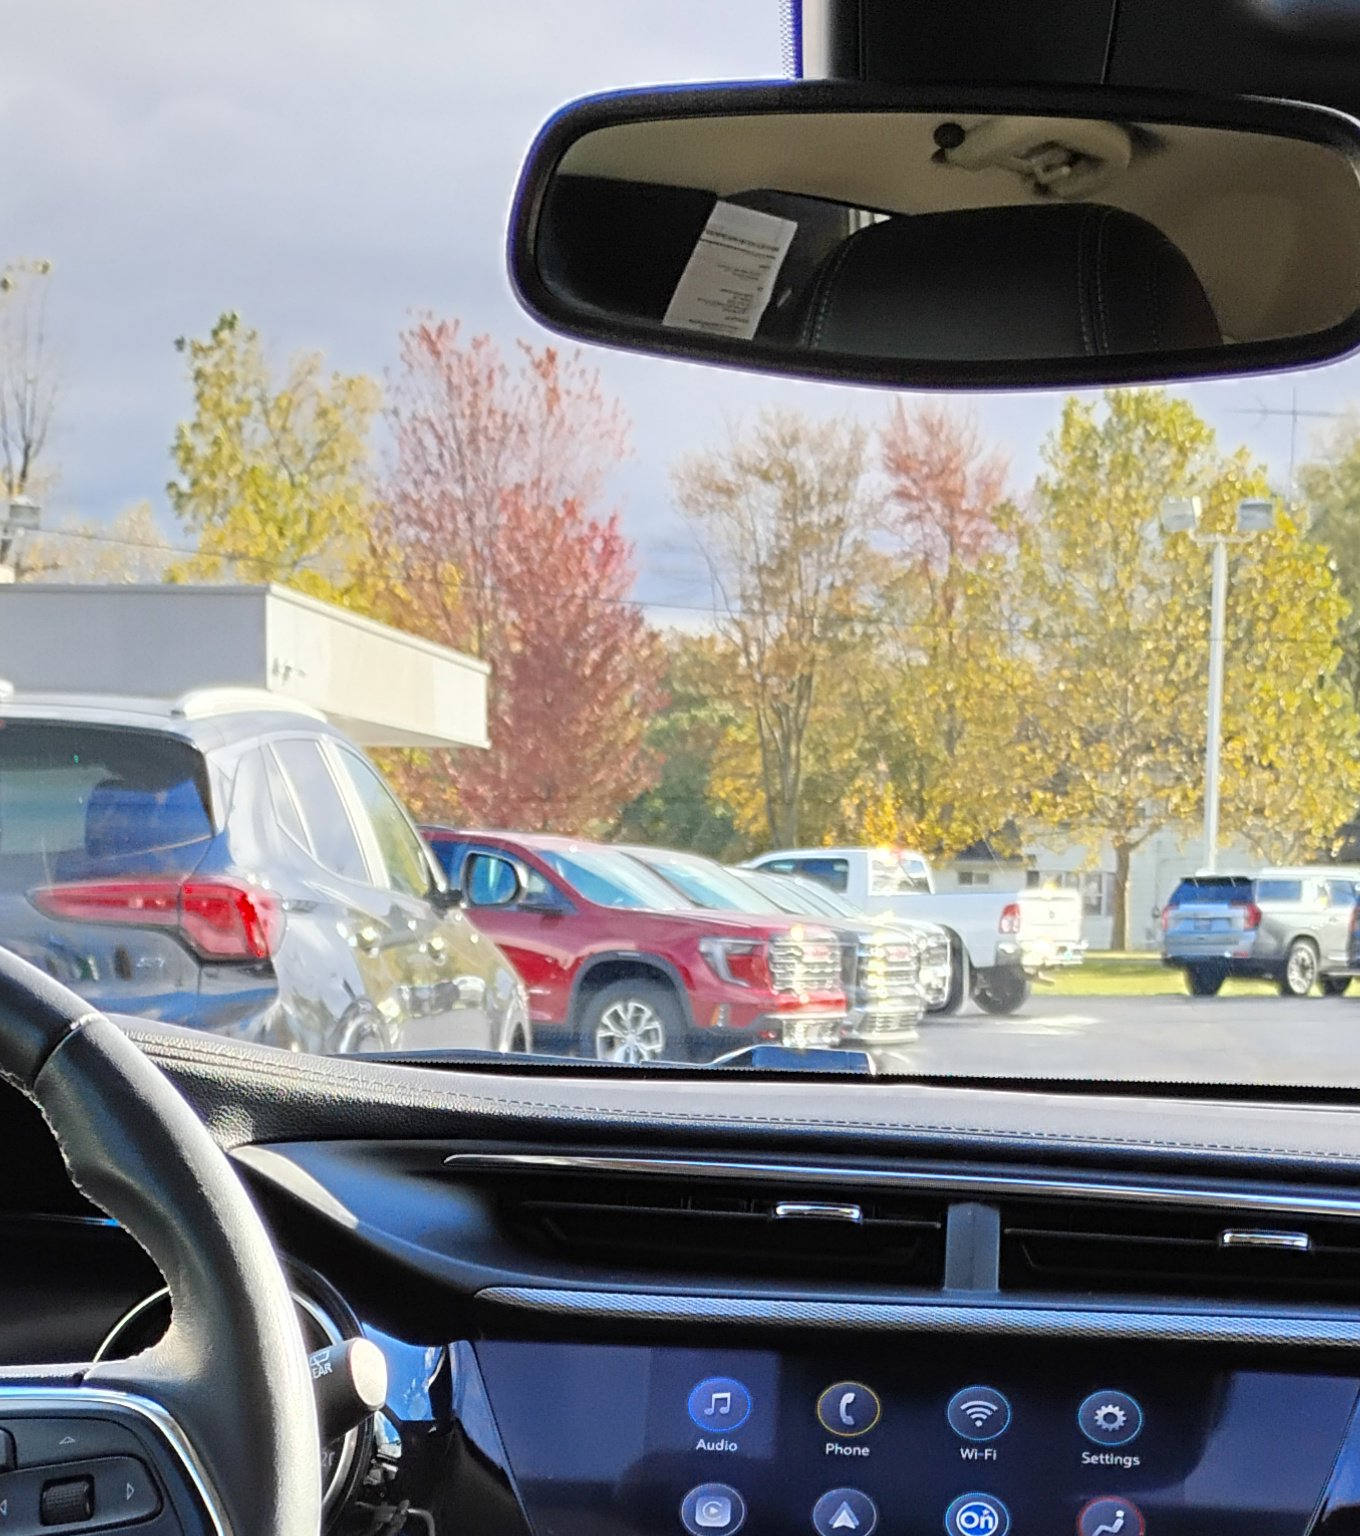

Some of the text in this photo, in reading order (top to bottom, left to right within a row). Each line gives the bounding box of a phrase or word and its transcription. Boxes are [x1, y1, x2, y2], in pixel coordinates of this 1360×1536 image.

[311, 1362, 334, 1379] EAR
[696, 1438, 739, 1453] Audio
[825, 1443, 871, 1457] Phone
[960, 1447, 998, 1461] Wi-Fi
[1081, 1451, 1141, 1469] Settings
